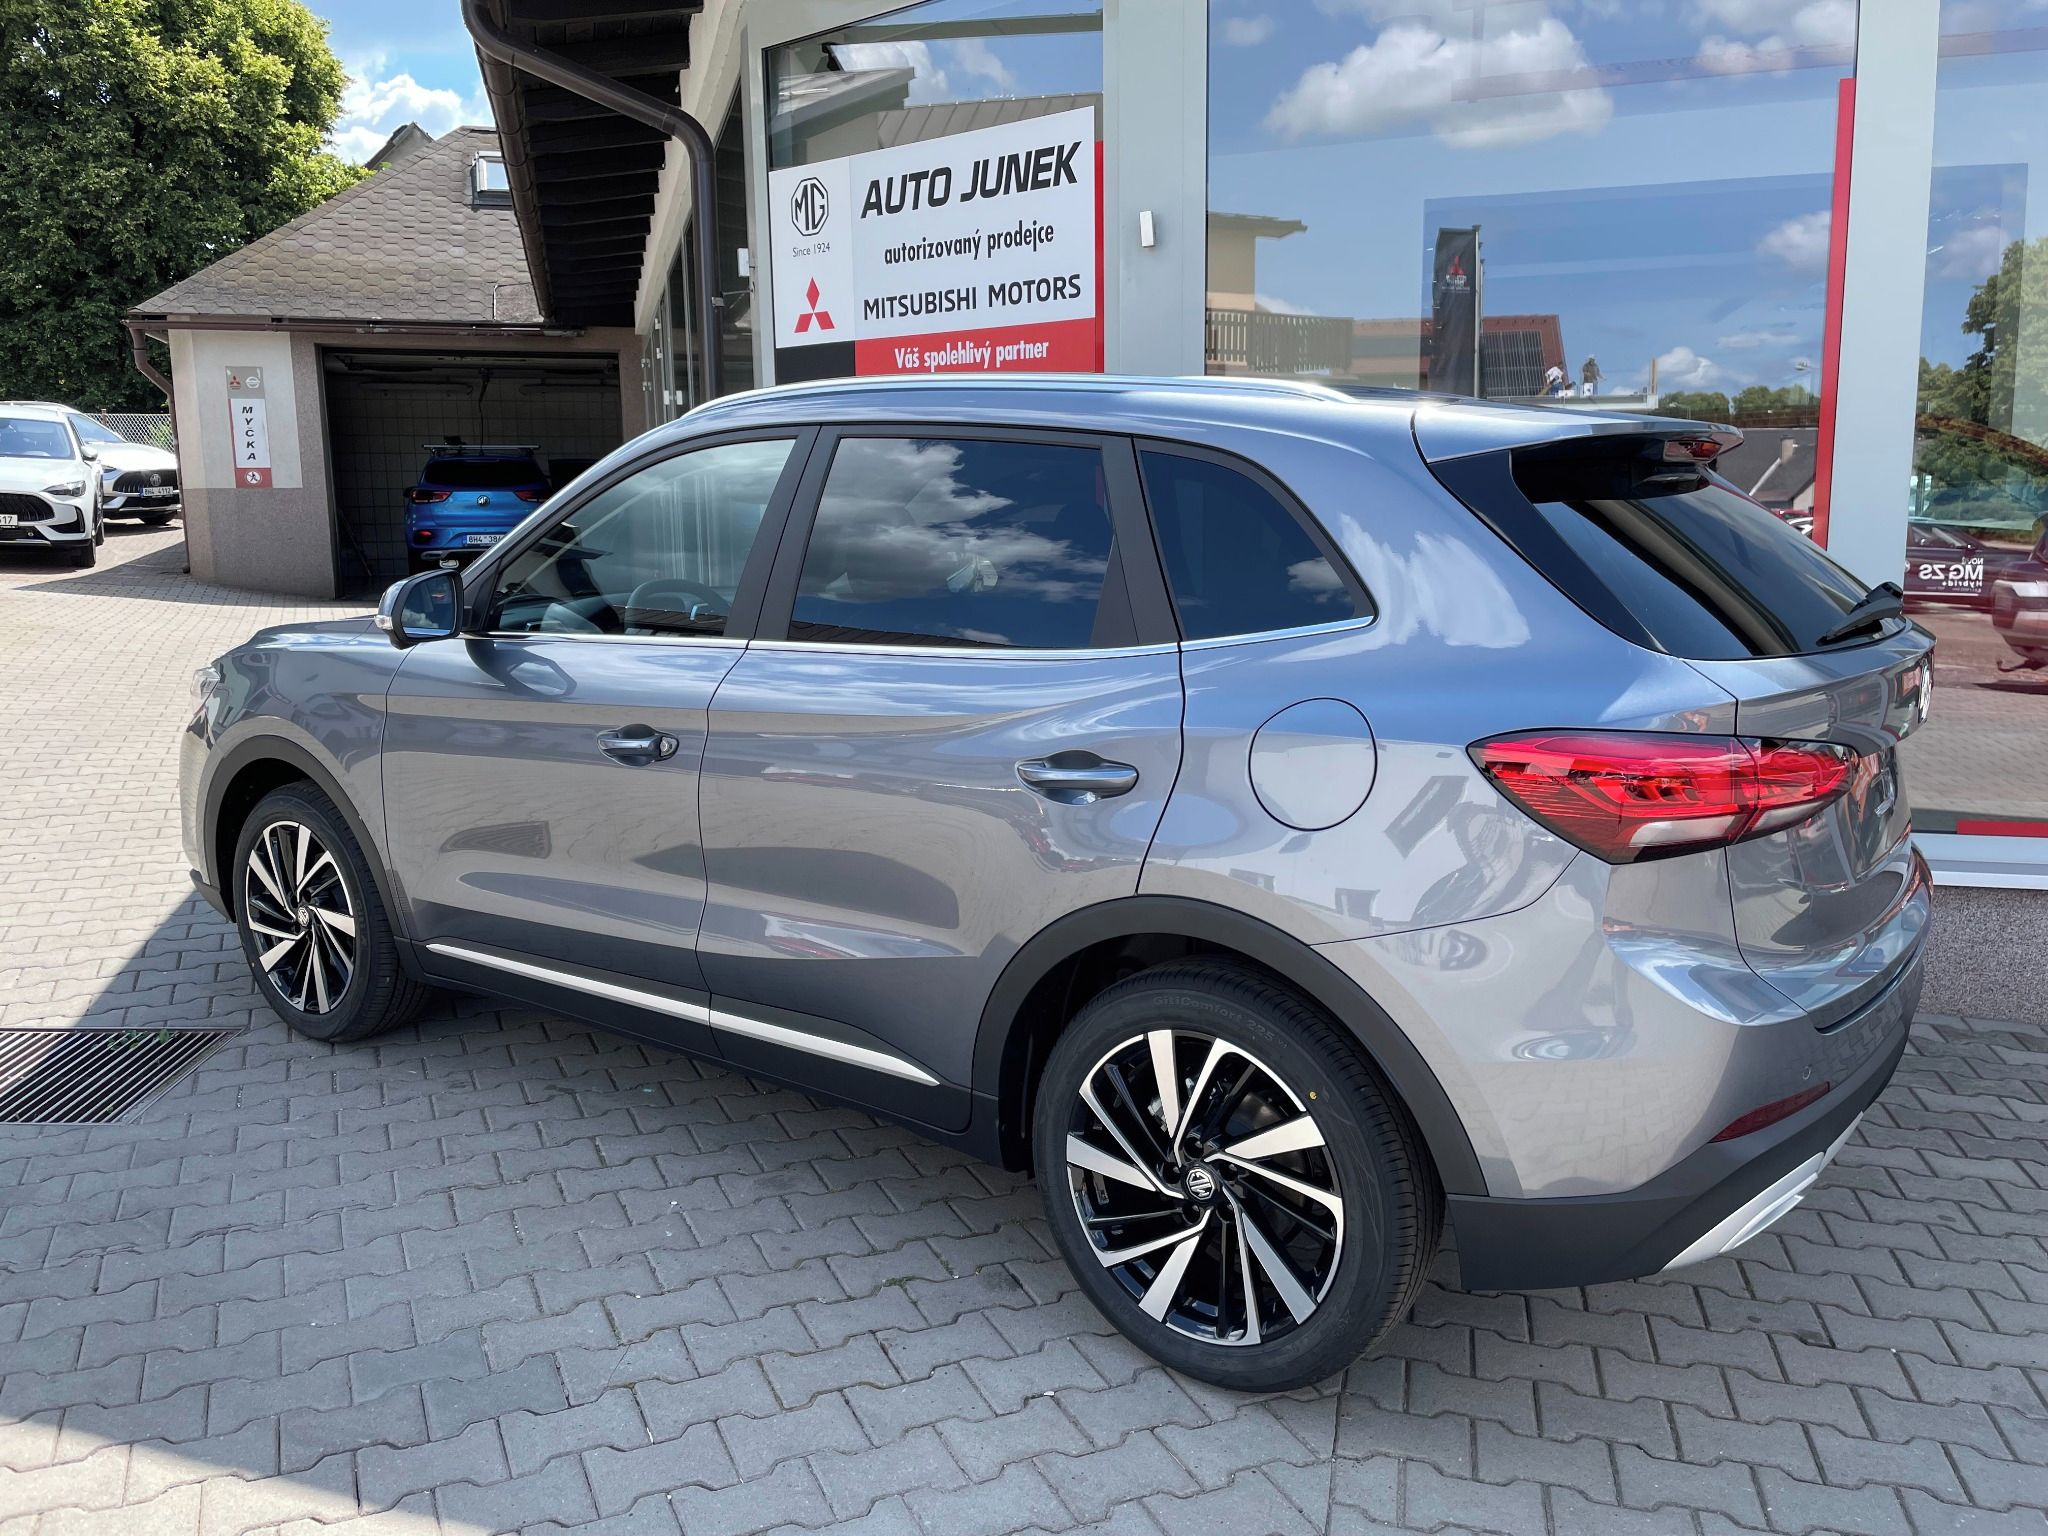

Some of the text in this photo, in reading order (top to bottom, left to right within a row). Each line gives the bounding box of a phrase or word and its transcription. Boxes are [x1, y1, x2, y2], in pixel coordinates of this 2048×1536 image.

[860, 141, 1082, 219] AUTO JUNEK
[794, 182, 826, 231] MG
[793, 242, 830, 258] Since 1924
[884, 220, 1054, 264] autorizovaný prodejce
[864, 274, 1081, 320] MITSUBISHI MOTORS
[894, 341, 1049, 372] Váš spolehlivý partner
[242, 406, 257, 461] MYČKA
[0, 515, 13, 525] 17
[1247, 1019, 1276, 1041] 225
